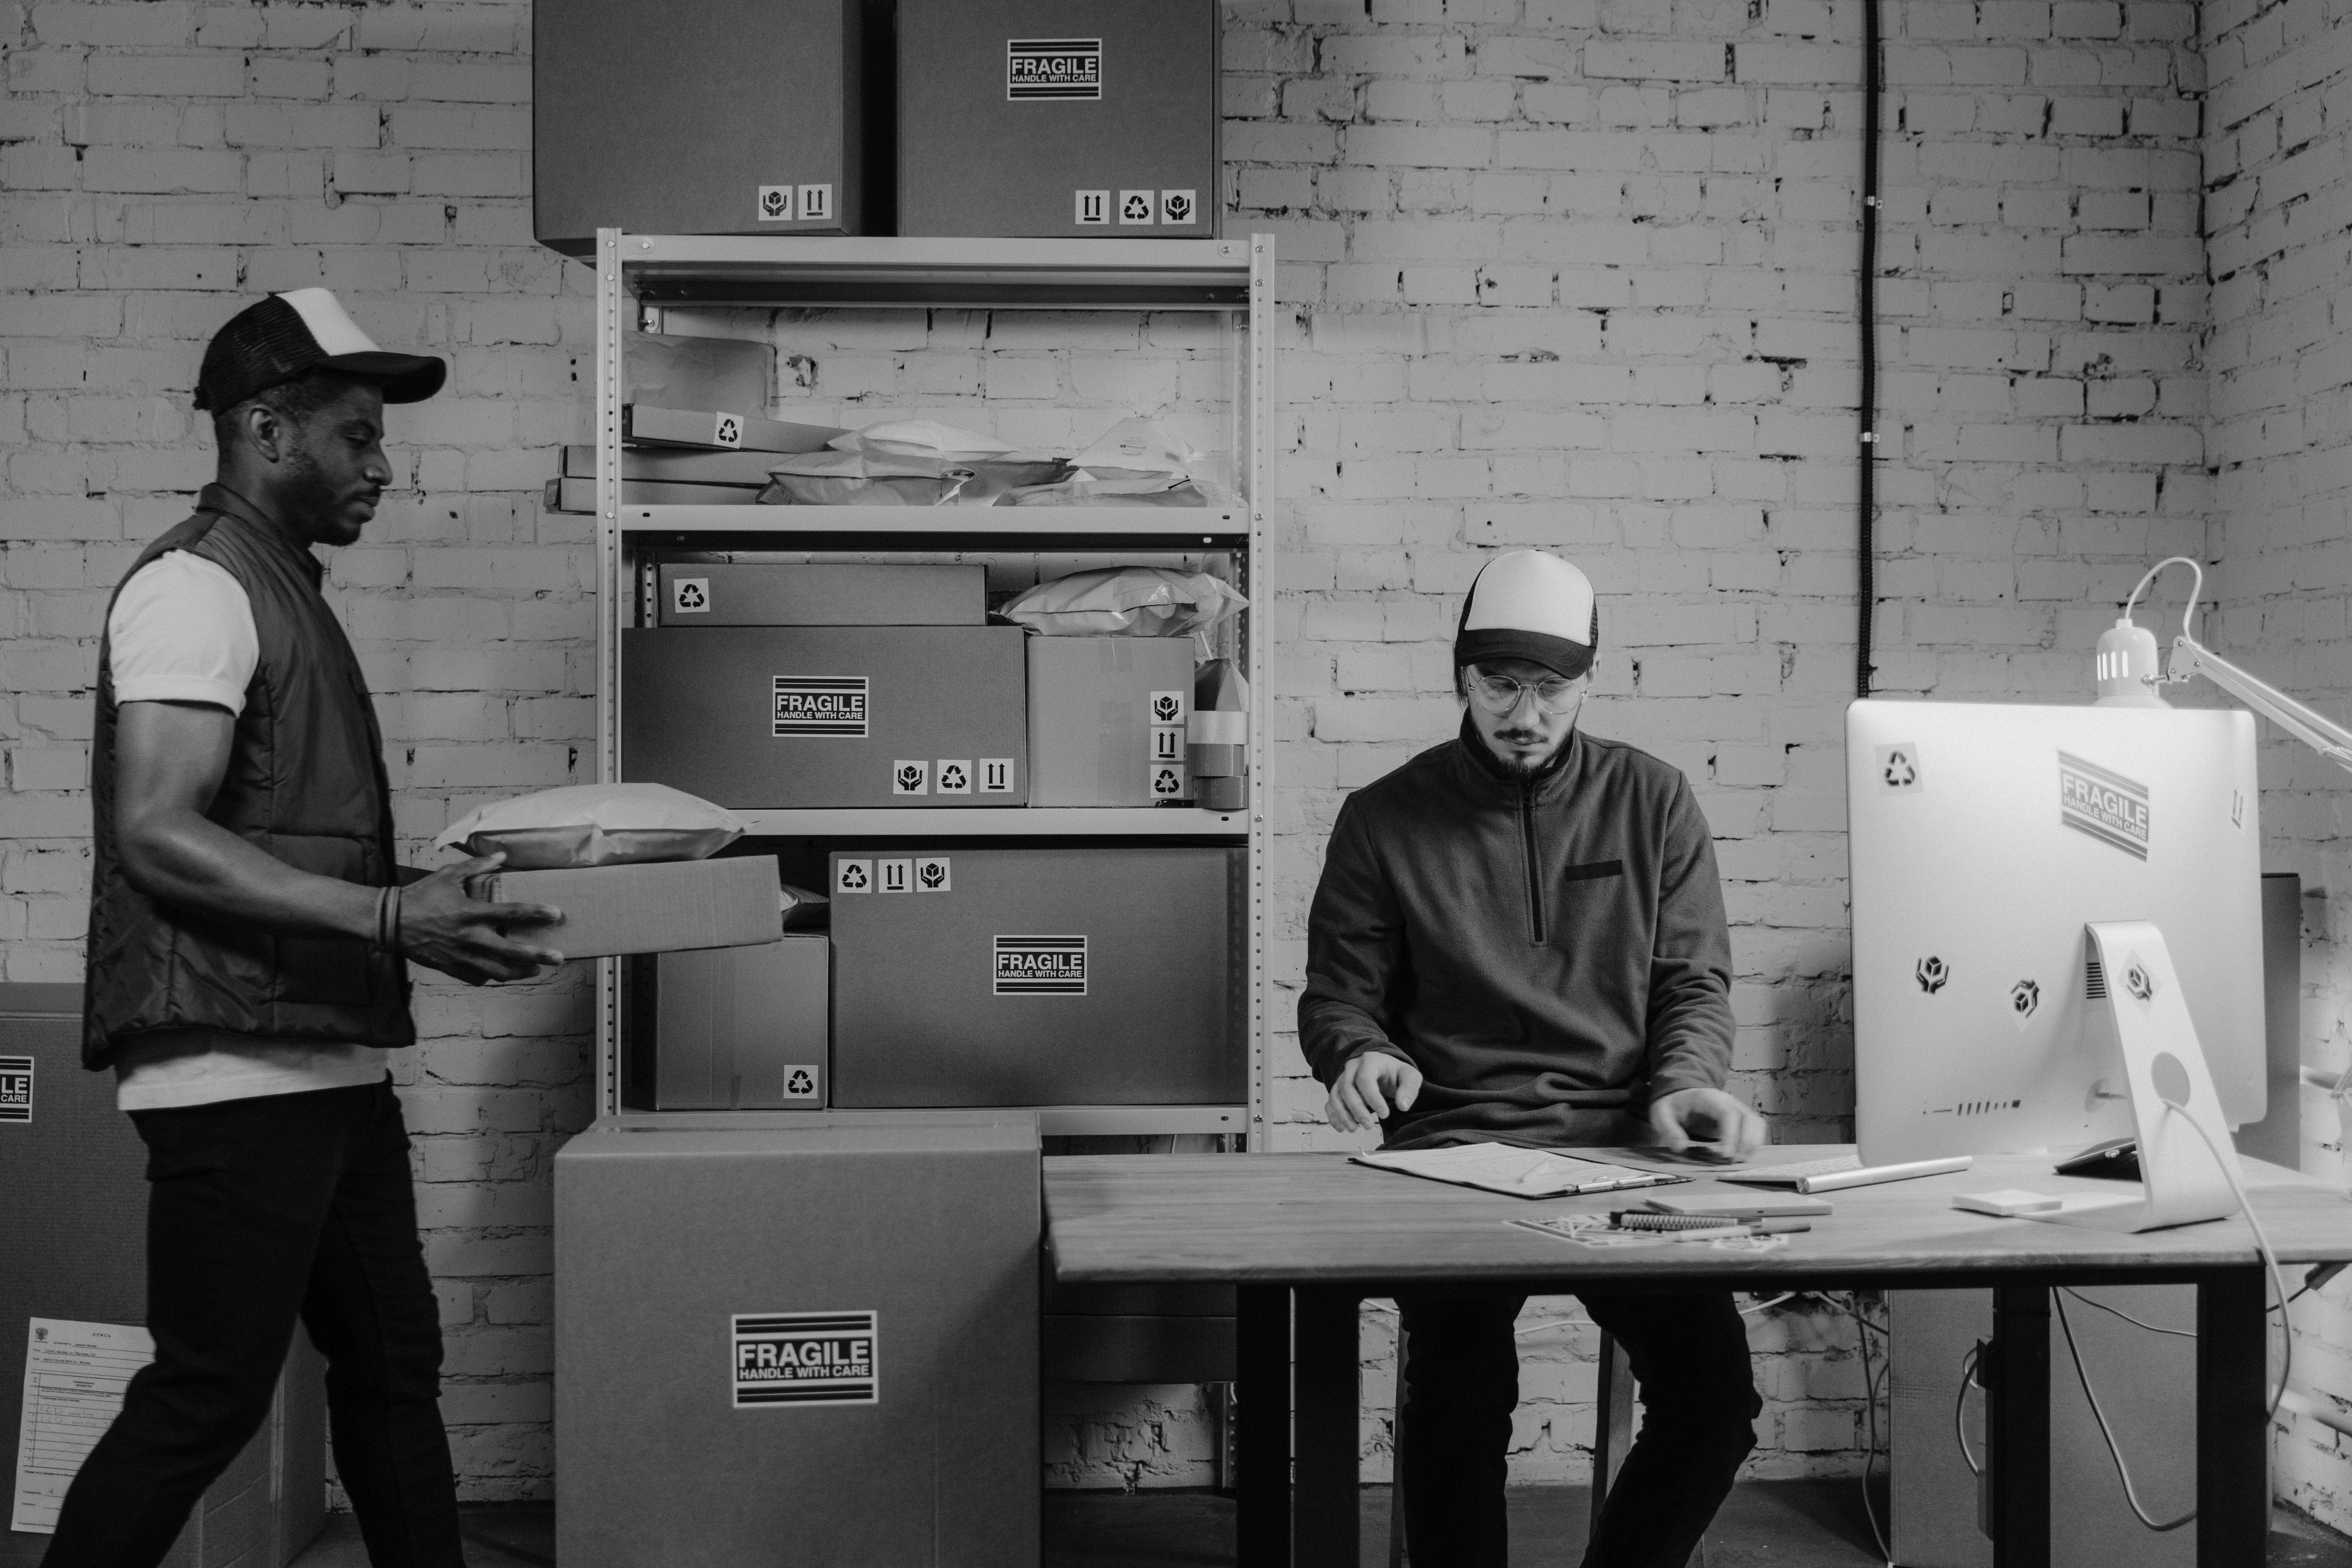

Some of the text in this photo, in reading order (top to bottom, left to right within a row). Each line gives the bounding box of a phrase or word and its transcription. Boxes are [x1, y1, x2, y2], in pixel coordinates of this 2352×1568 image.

[1012, 58, 1097, 74] FRAGILE
[777, 695, 863, 711] FRAGILE
[2063, 773, 2147, 829] FRAGILE
[2063, 795, 2146, 840] HANDLE WITH CARE
[998, 954, 1082, 970] FRAGILE
[1, 1094, 27, 1103] CARE
[739, 1340, 869, 1367] FRAGILE
[740, 1365, 869, 1379] HANDLE WITH CARE
